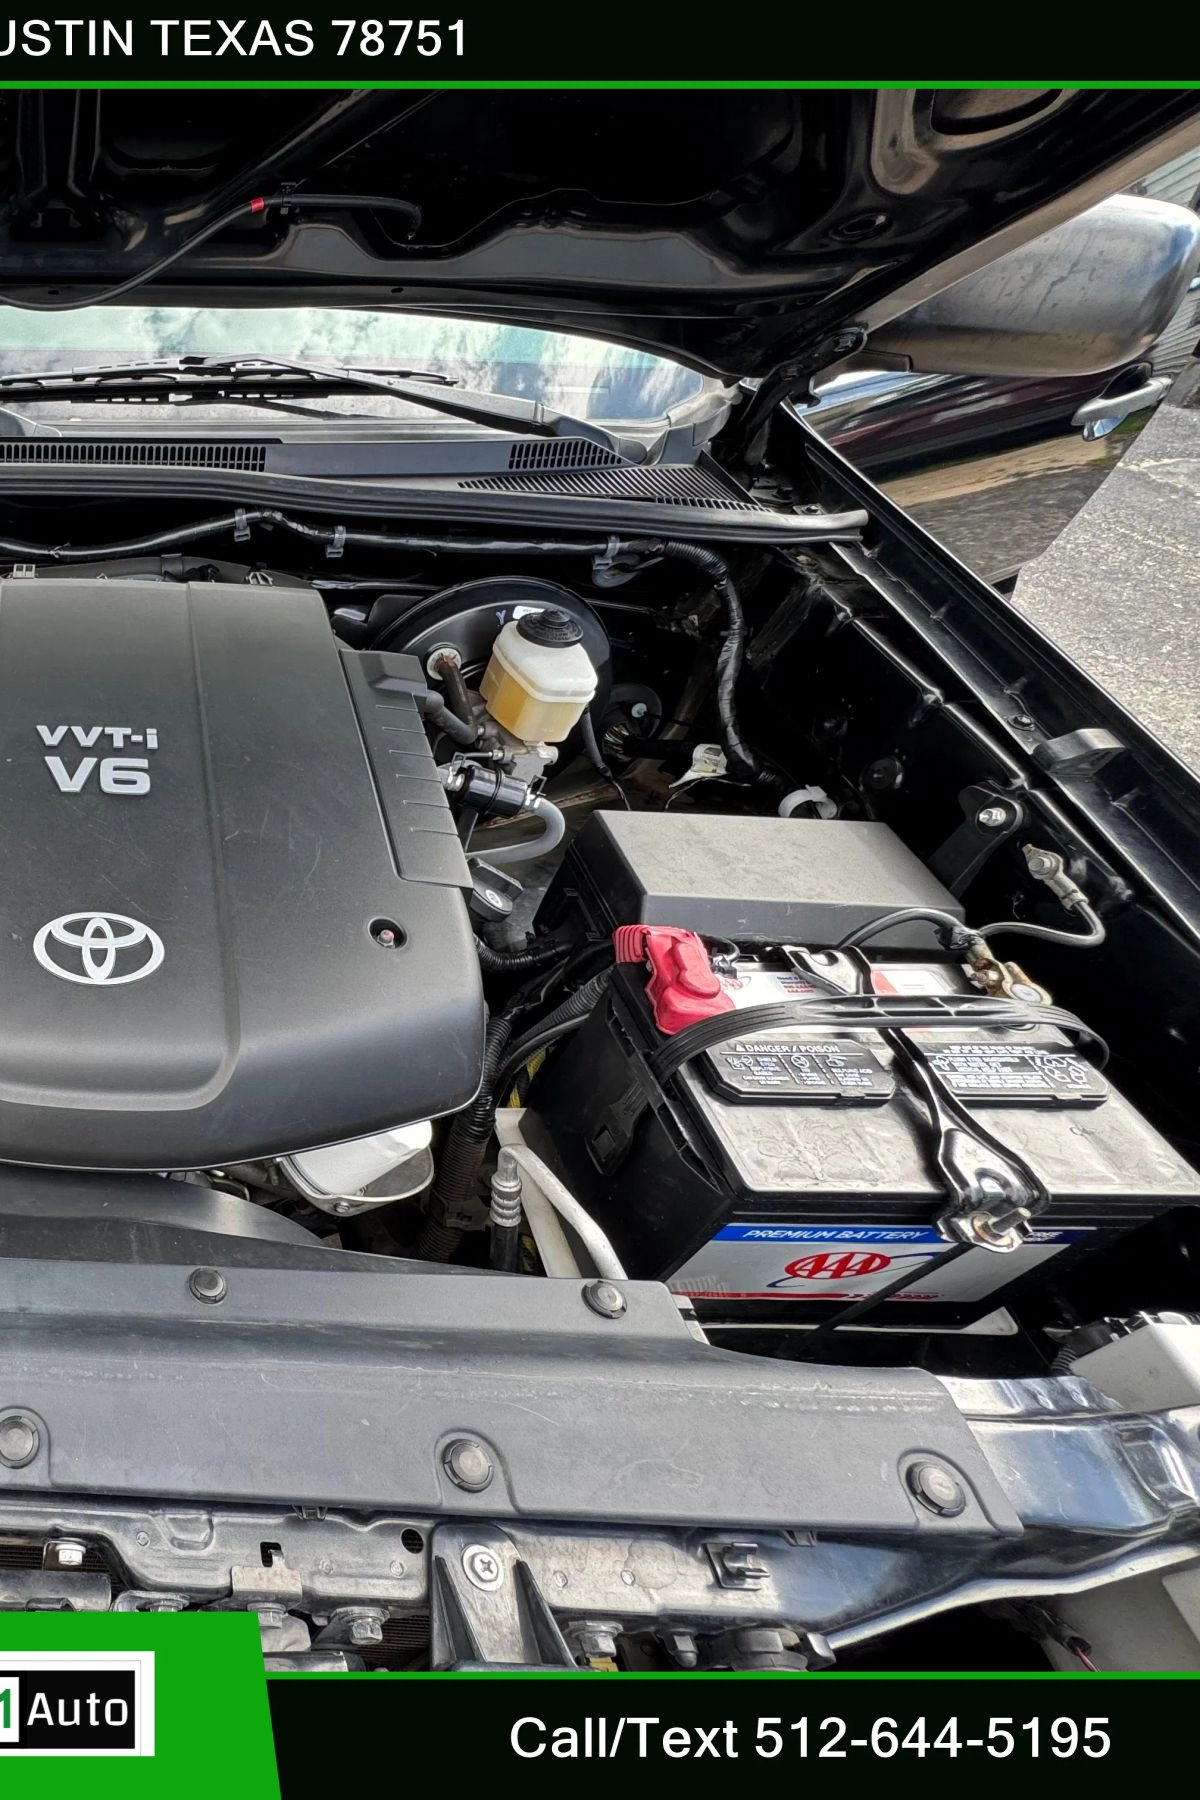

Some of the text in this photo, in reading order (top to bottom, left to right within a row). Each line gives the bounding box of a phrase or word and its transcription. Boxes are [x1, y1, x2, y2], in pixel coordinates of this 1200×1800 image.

[36, 724, 159, 749] VVT-i
[44, 755, 151, 795] V6
[798, 1045, 841, 1053] POISON
[743, 1230, 929, 1240] PREMIUM BATTERY
[794, 1252, 884, 1278] AAA
